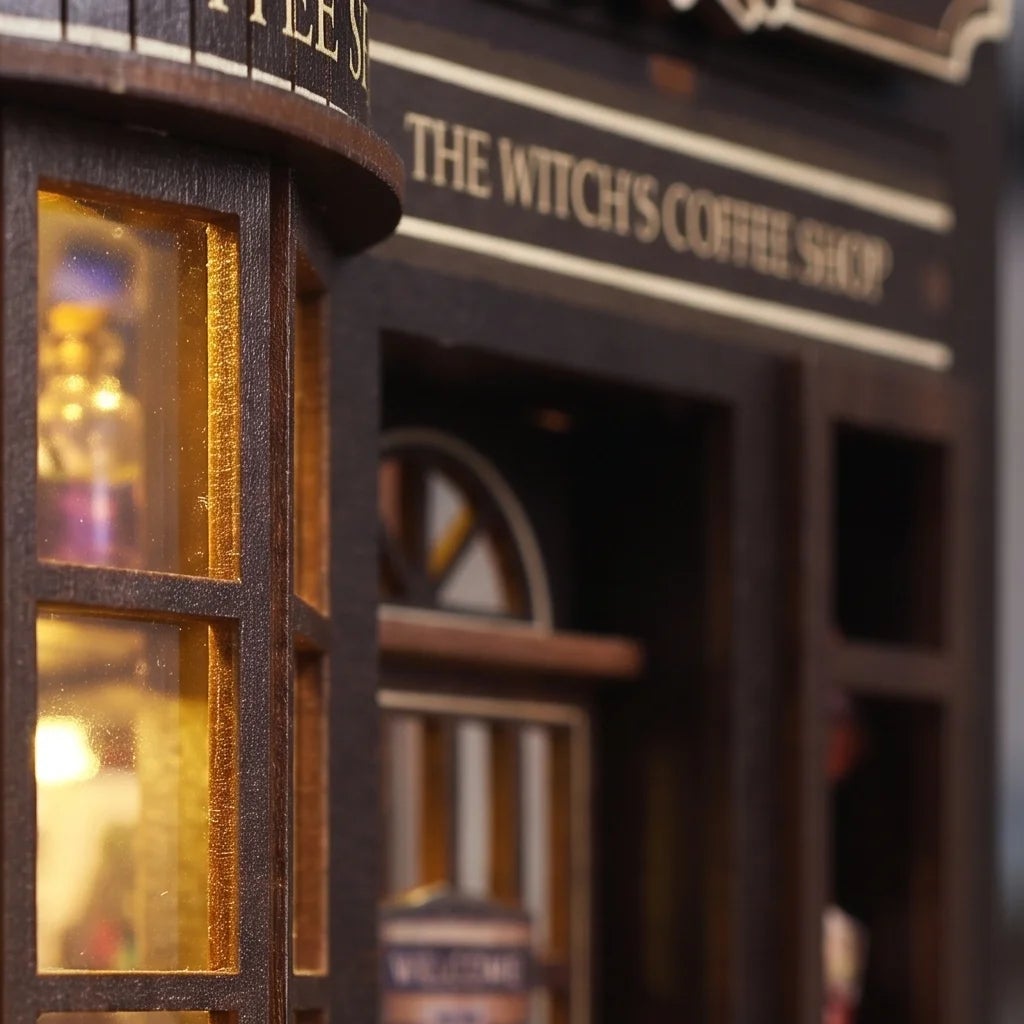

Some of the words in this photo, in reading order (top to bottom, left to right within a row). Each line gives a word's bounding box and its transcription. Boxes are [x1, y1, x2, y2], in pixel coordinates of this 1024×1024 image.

[404, 111, 492, 198] THE
[497, 137, 661, 244] WITCH'S
[662, 181, 795, 280] COFFEE
[796, 217, 894, 304] SHOP
